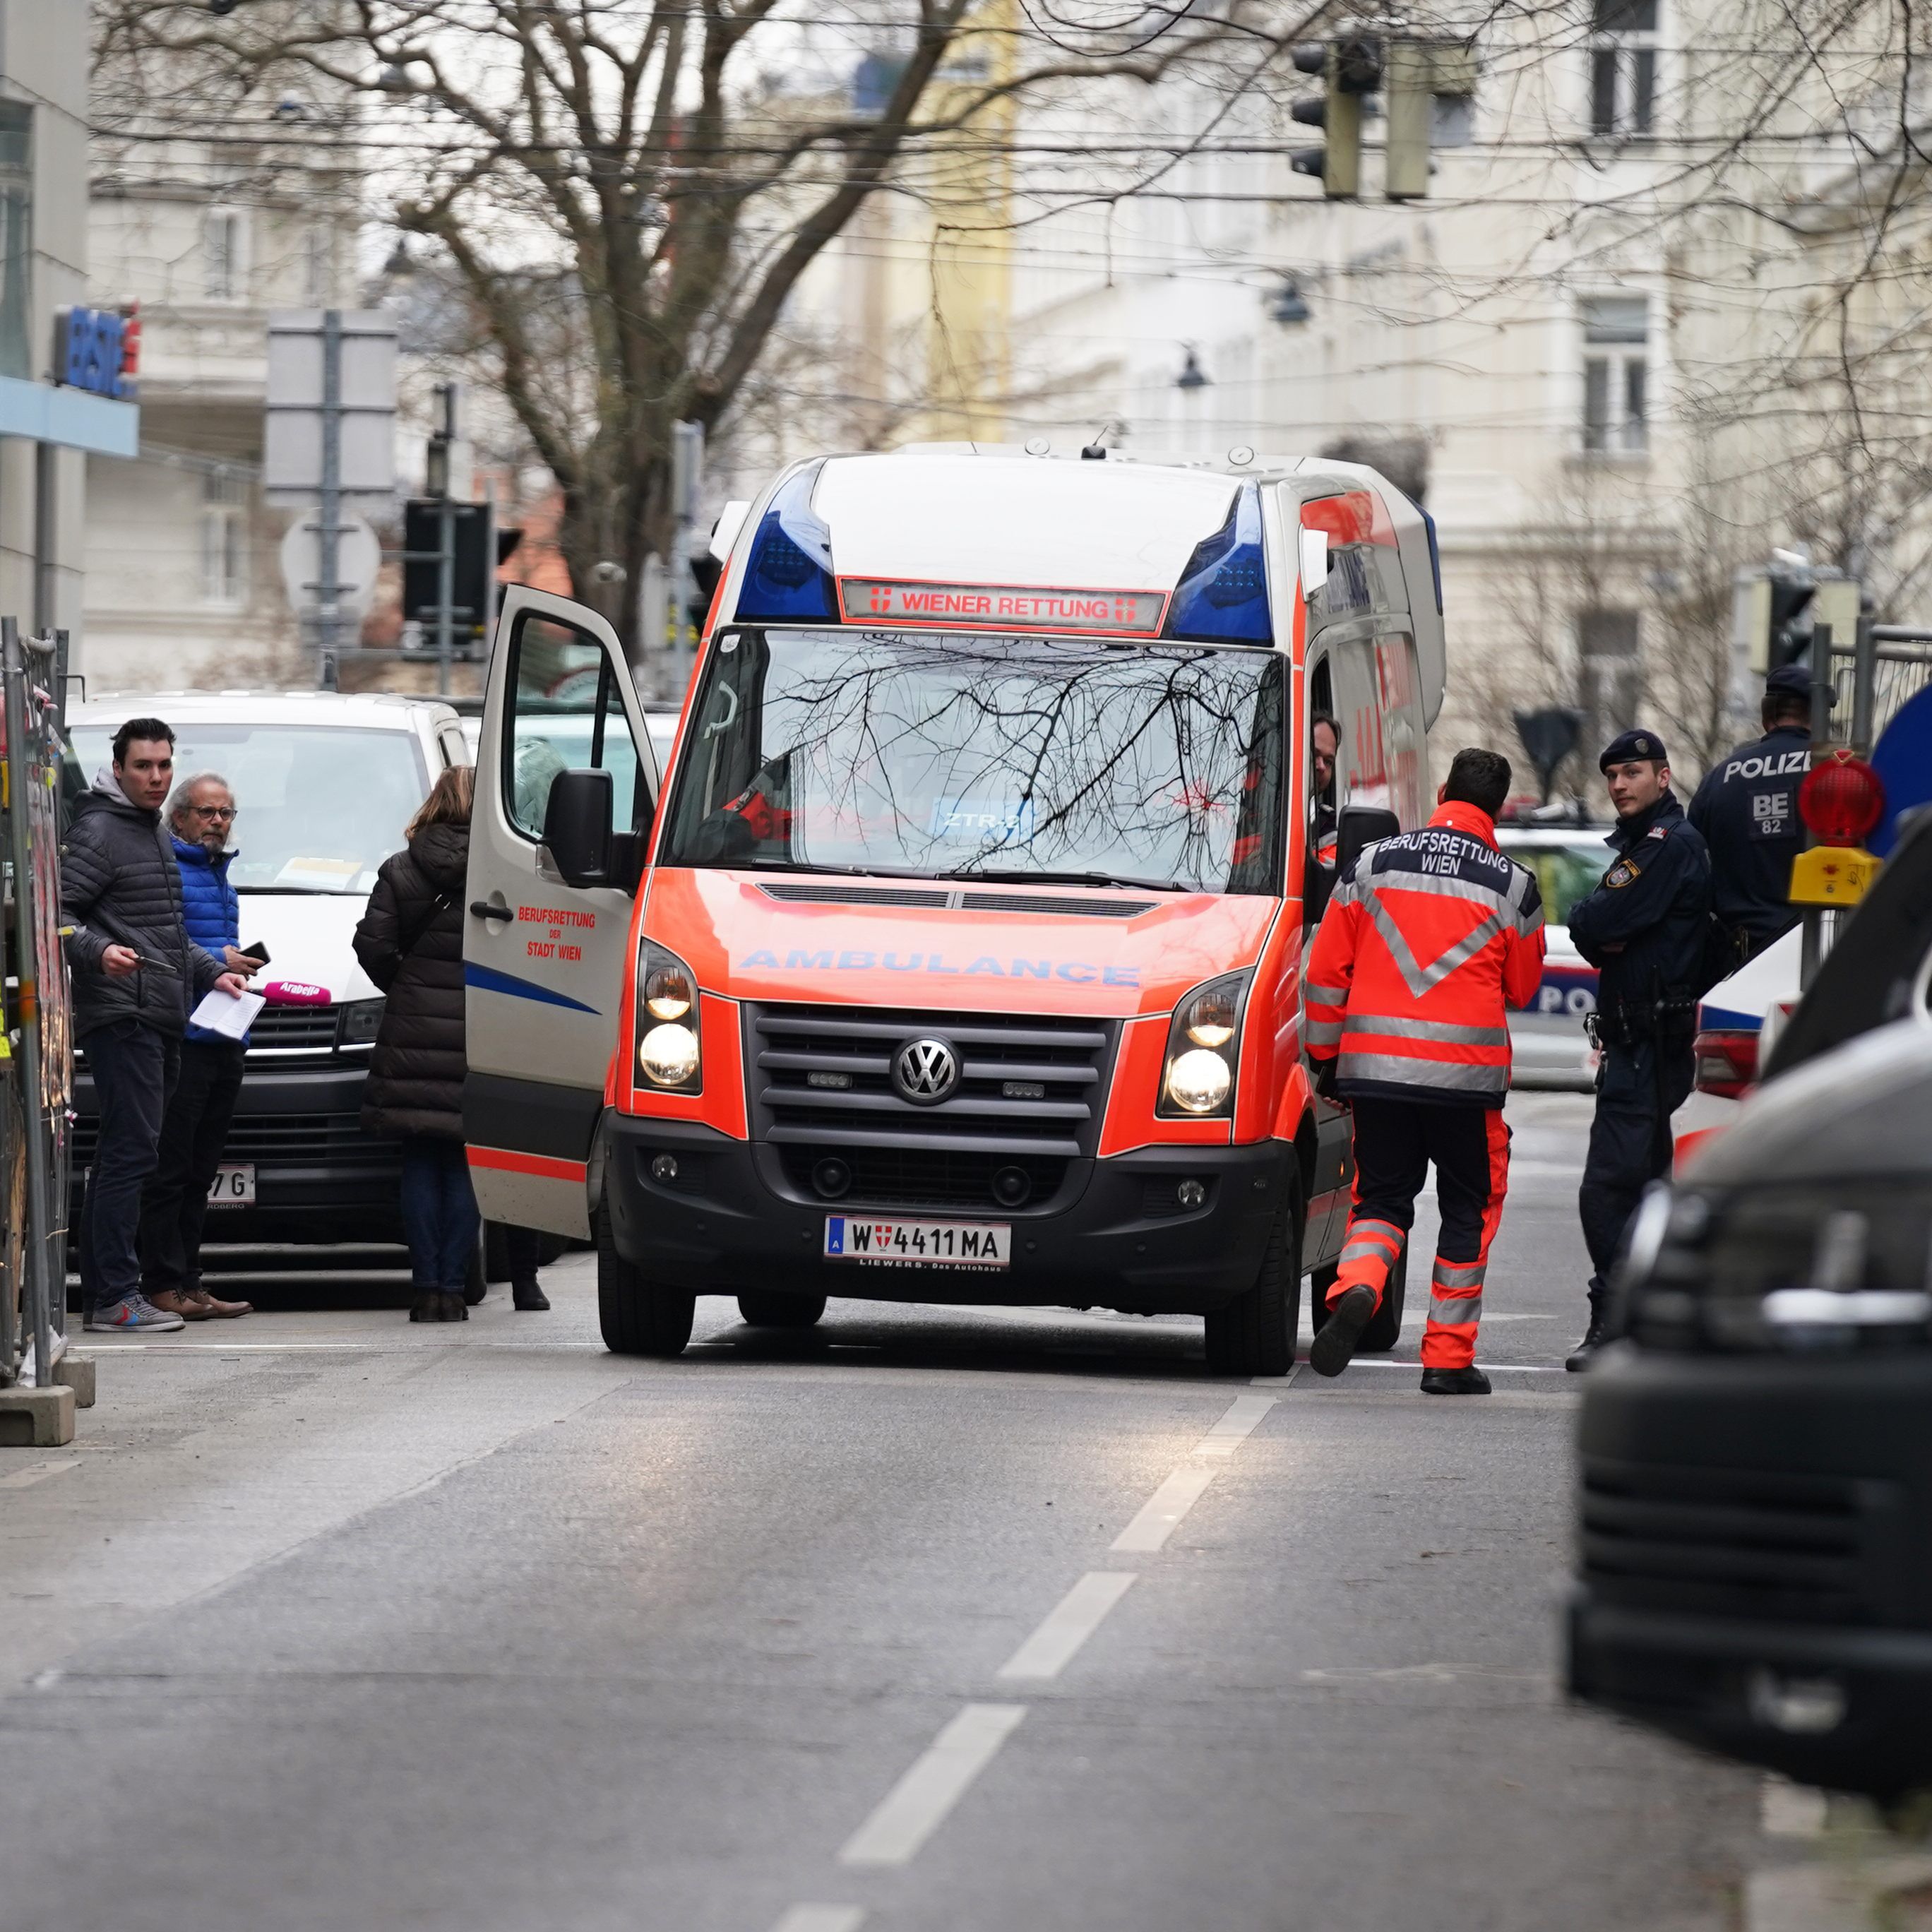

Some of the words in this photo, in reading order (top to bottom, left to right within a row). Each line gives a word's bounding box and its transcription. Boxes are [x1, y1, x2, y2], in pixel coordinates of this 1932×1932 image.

[902, 592, 991, 614] WIENER
[998, 597, 1109, 619] RETTUNG
[1753, 792, 1789, 817] BE
[1761, 819, 1782, 834] 82
[1378, 832, 1509, 873] BERUFSRETTUNG
[1421, 854, 1462, 876] WIEN
[518, 906, 595, 929] BERUFSRETTUNG
[549, 929, 561, 939] DER
[527, 941, 555, 958] STADT
[559, 944, 581, 961] WIEN
[739, 949, 1140, 988] AMBULANCE
[280, 982, 321, 996] Arabella
[955, 1263, 1001, 1272] Autohaus
